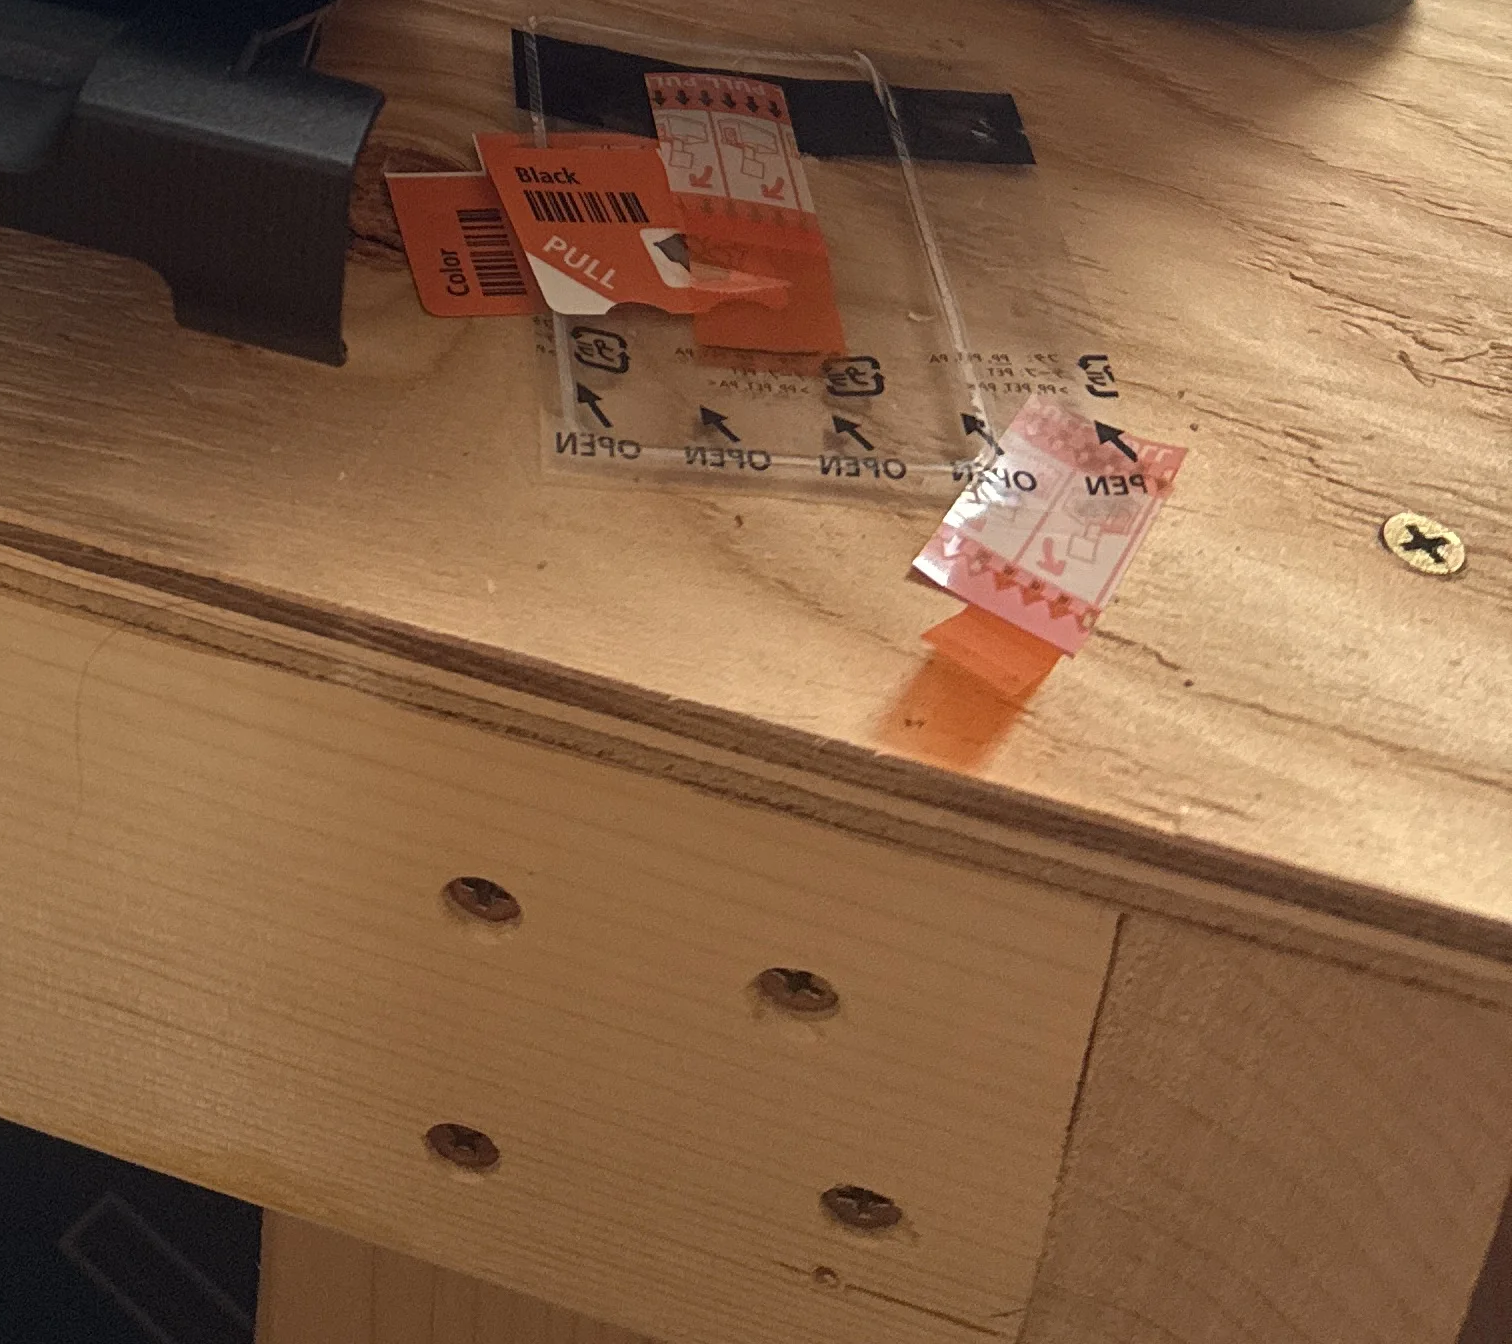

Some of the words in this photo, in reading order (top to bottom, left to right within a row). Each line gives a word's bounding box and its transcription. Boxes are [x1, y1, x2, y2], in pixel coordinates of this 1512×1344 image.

[515, 165, 581, 185] Black
[439, 247, 470, 297] Color
[542, 234, 619, 290] PULL
